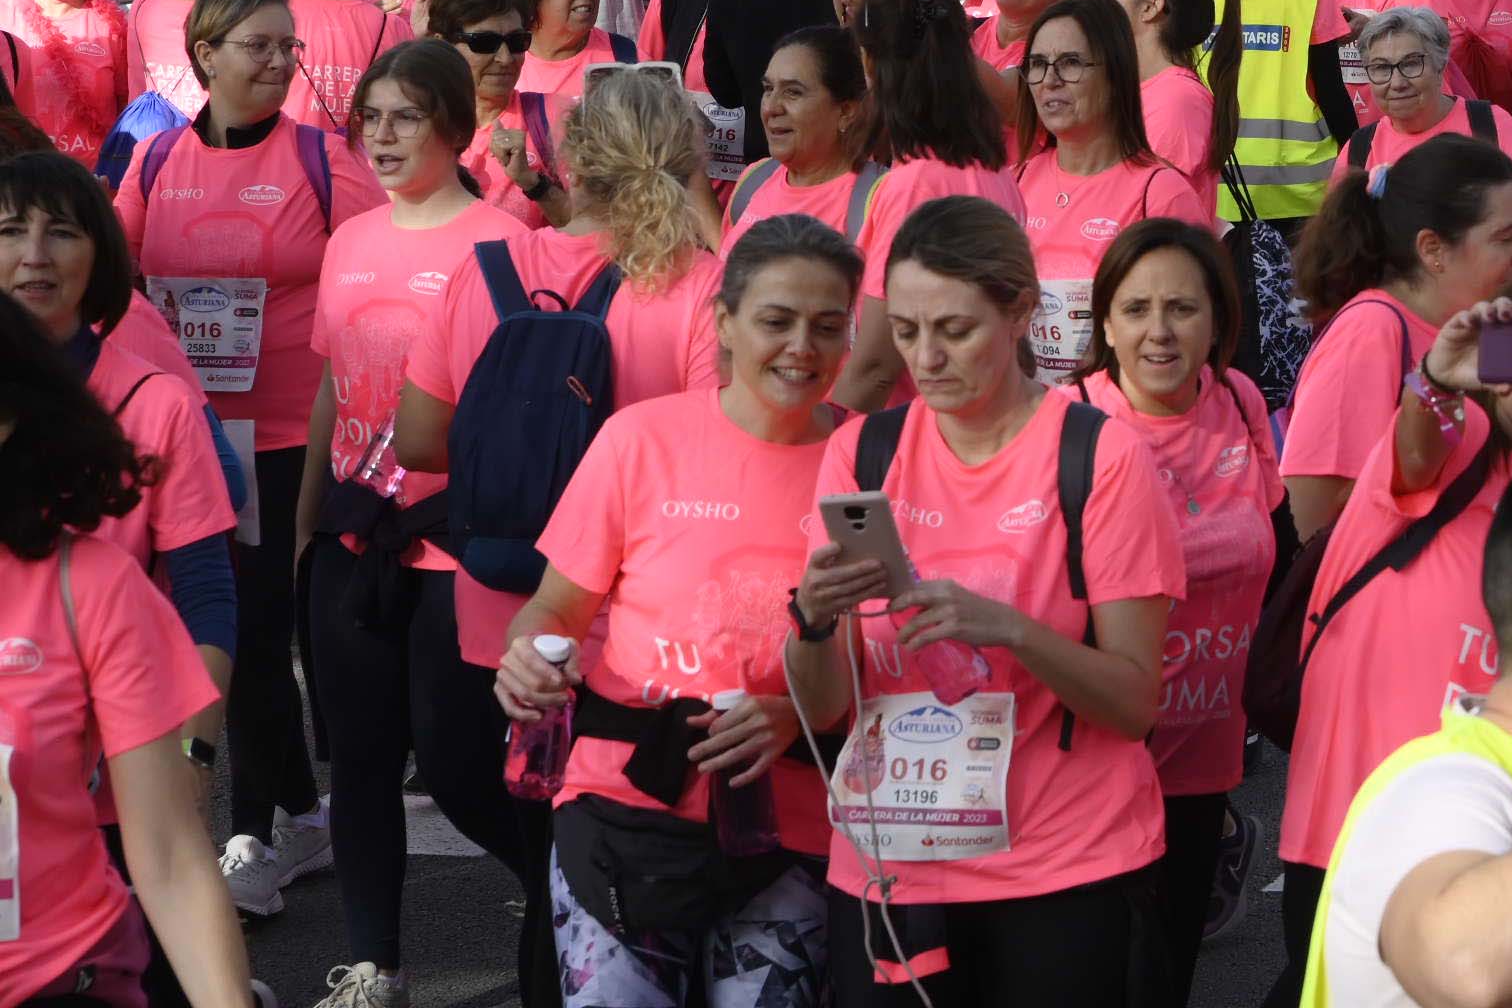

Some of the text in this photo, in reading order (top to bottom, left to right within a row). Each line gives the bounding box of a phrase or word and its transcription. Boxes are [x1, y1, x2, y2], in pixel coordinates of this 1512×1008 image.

[314, 80, 334, 97] DE
[184, 296, 226, 307] ASTURIANA
[1066, 295, 1089, 303] SUMA
[184, 321, 222, 338] 016
[1031, 322, 1062, 342] 016
[187, 343, 216, 353] 25833
[663, 499, 740, 522] OYSHO
[893, 720, 957, 735] ASTURIANA
[890, 757, 948, 783] 016
[894, 789, 939, 805] 13196
[894, 810, 907, 822] DE
[910, 810, 925, 823] LA
[925, 811, 960, 823] MUJER
[963, 813, 988, 823] 2023
[935, 835, 994, 847] Santander
